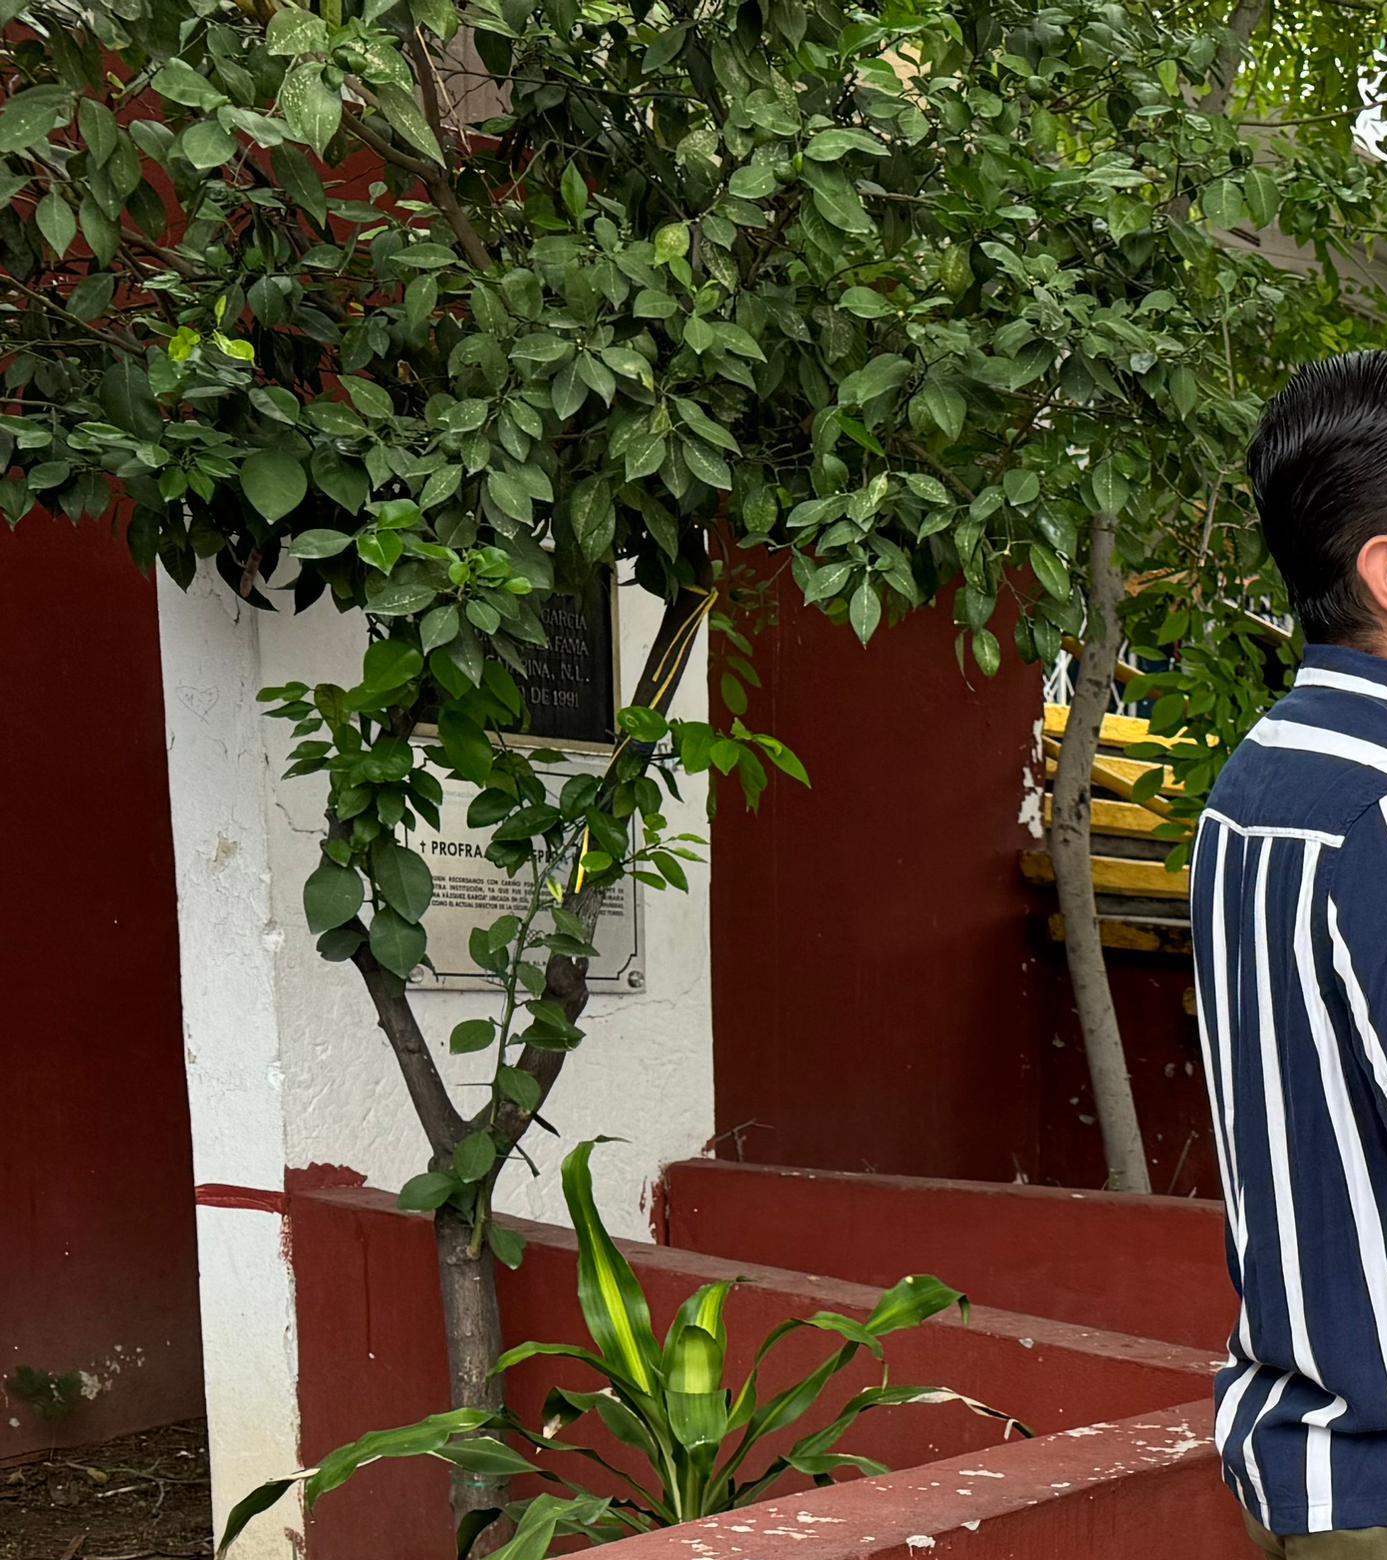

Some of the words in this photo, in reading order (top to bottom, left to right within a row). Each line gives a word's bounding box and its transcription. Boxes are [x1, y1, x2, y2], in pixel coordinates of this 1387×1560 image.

[555, 636, 589, 655] FAMA
[531, 686, 550, 705] DE
[553, 690, 579, 707] 1991
